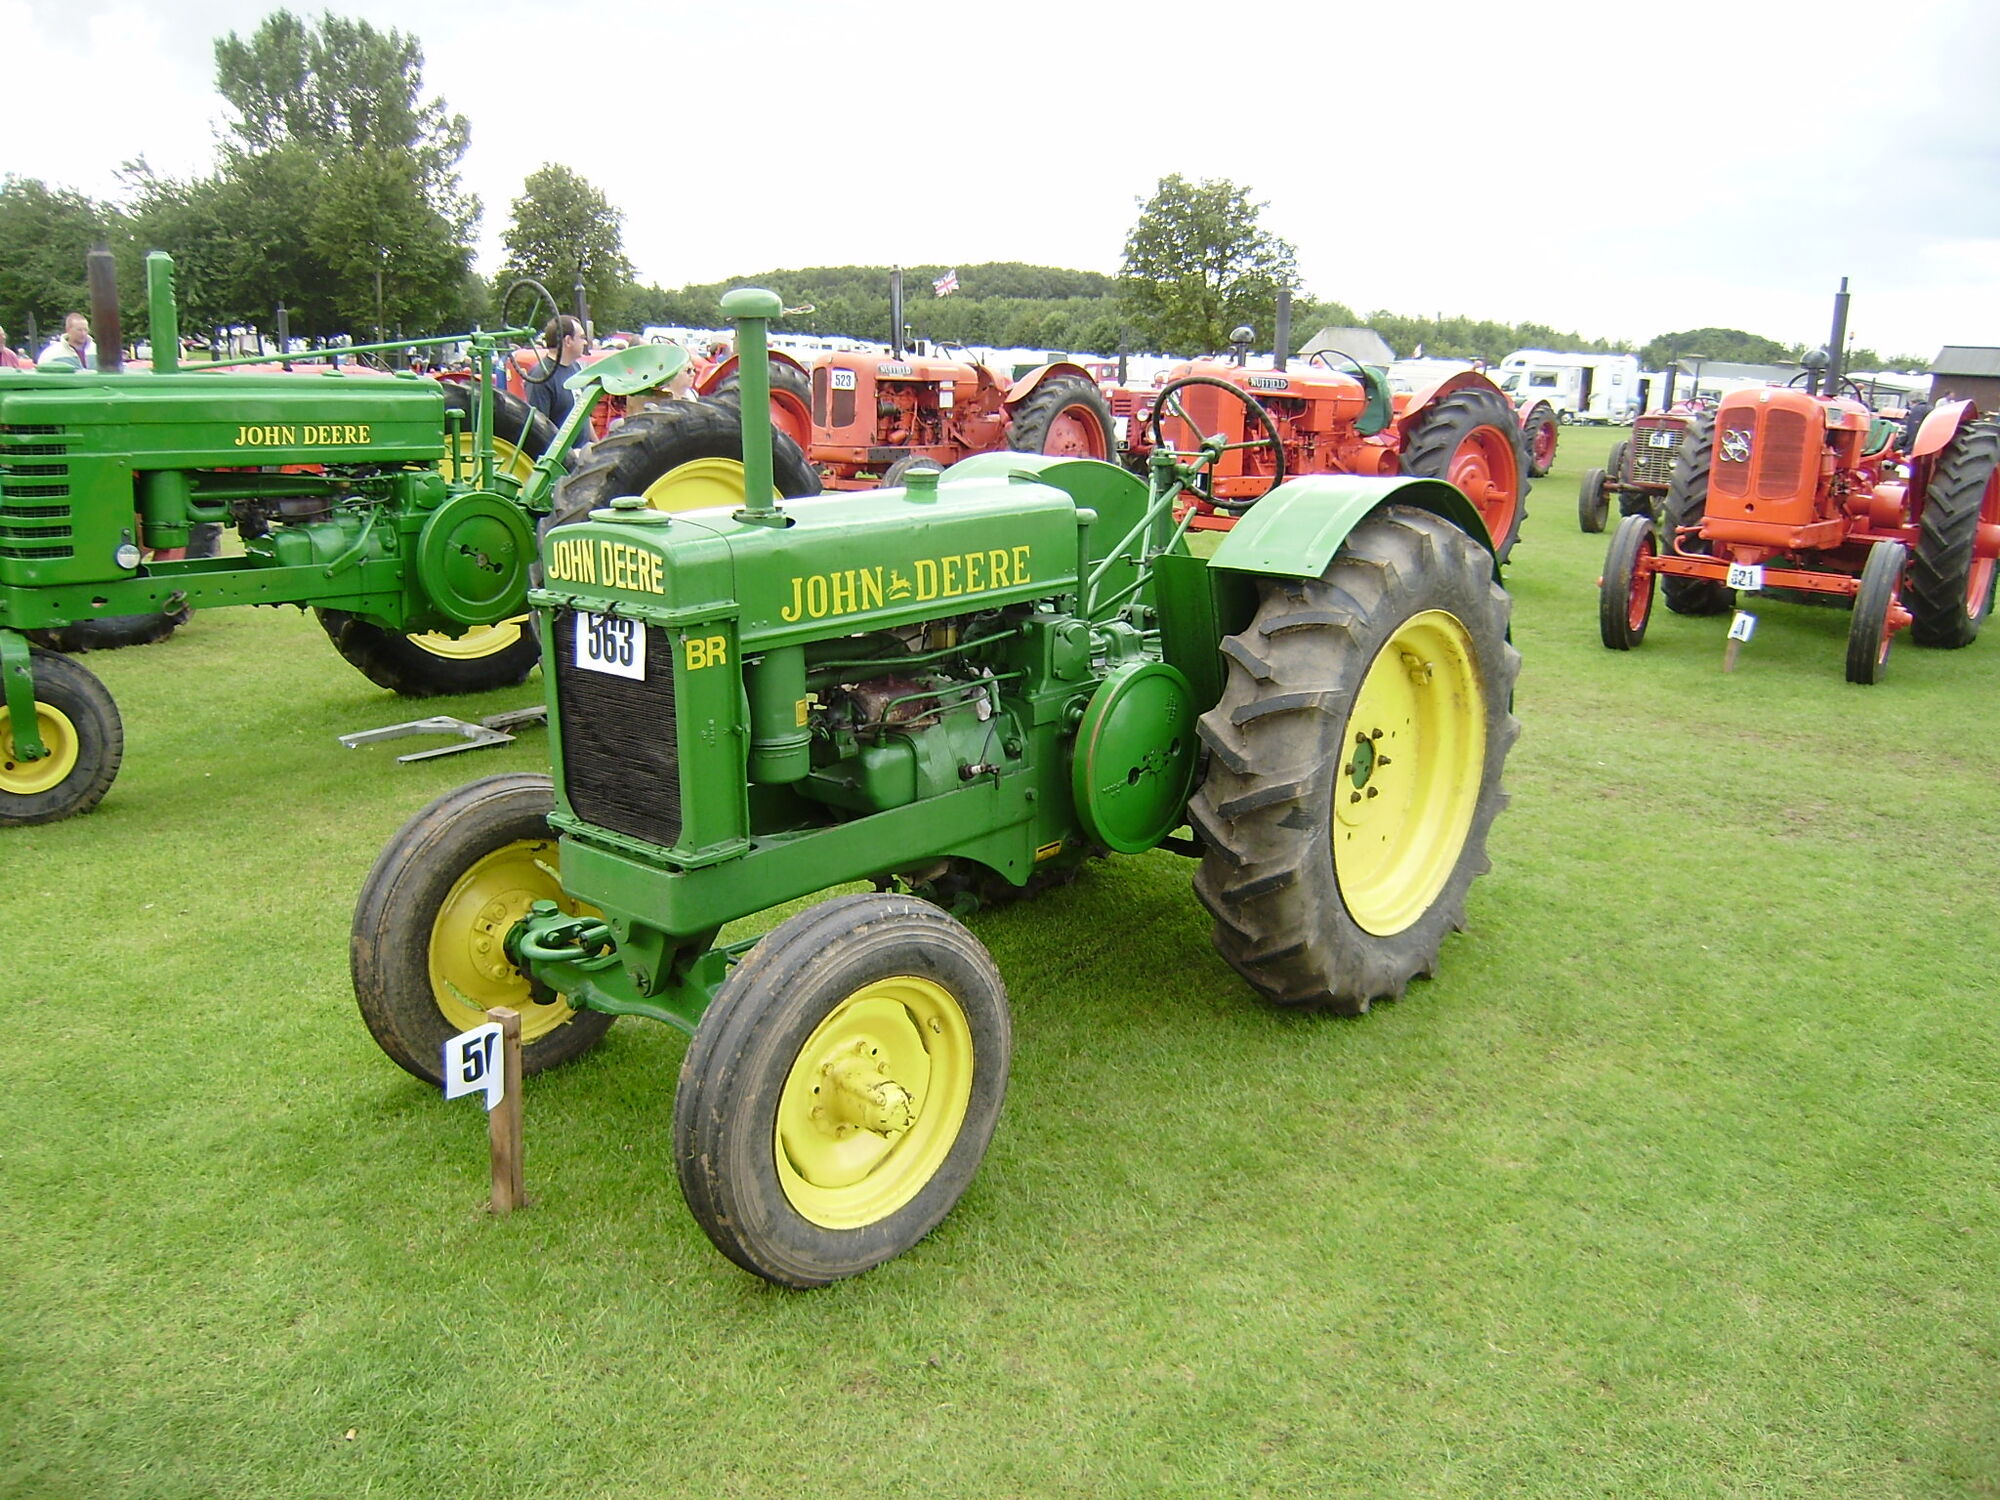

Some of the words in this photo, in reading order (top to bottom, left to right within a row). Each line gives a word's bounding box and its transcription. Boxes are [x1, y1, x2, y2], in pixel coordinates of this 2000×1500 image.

[835, 374, 852, 387] 523
[1250, 377, 1287, 389] NUFFIELD
[234, 426, 296, 446] JOHN
[303, 425, 371, 445] DEERE
[548, 539, 596, 585] JOHN
[600, 540, 665, 594] DEERE
[781, 566, 884, 622] JOHN
[914, 545, 1031, 601] DEERE
[588, 611, 635, 667] 563
[685, 635, 727, 671] BR
